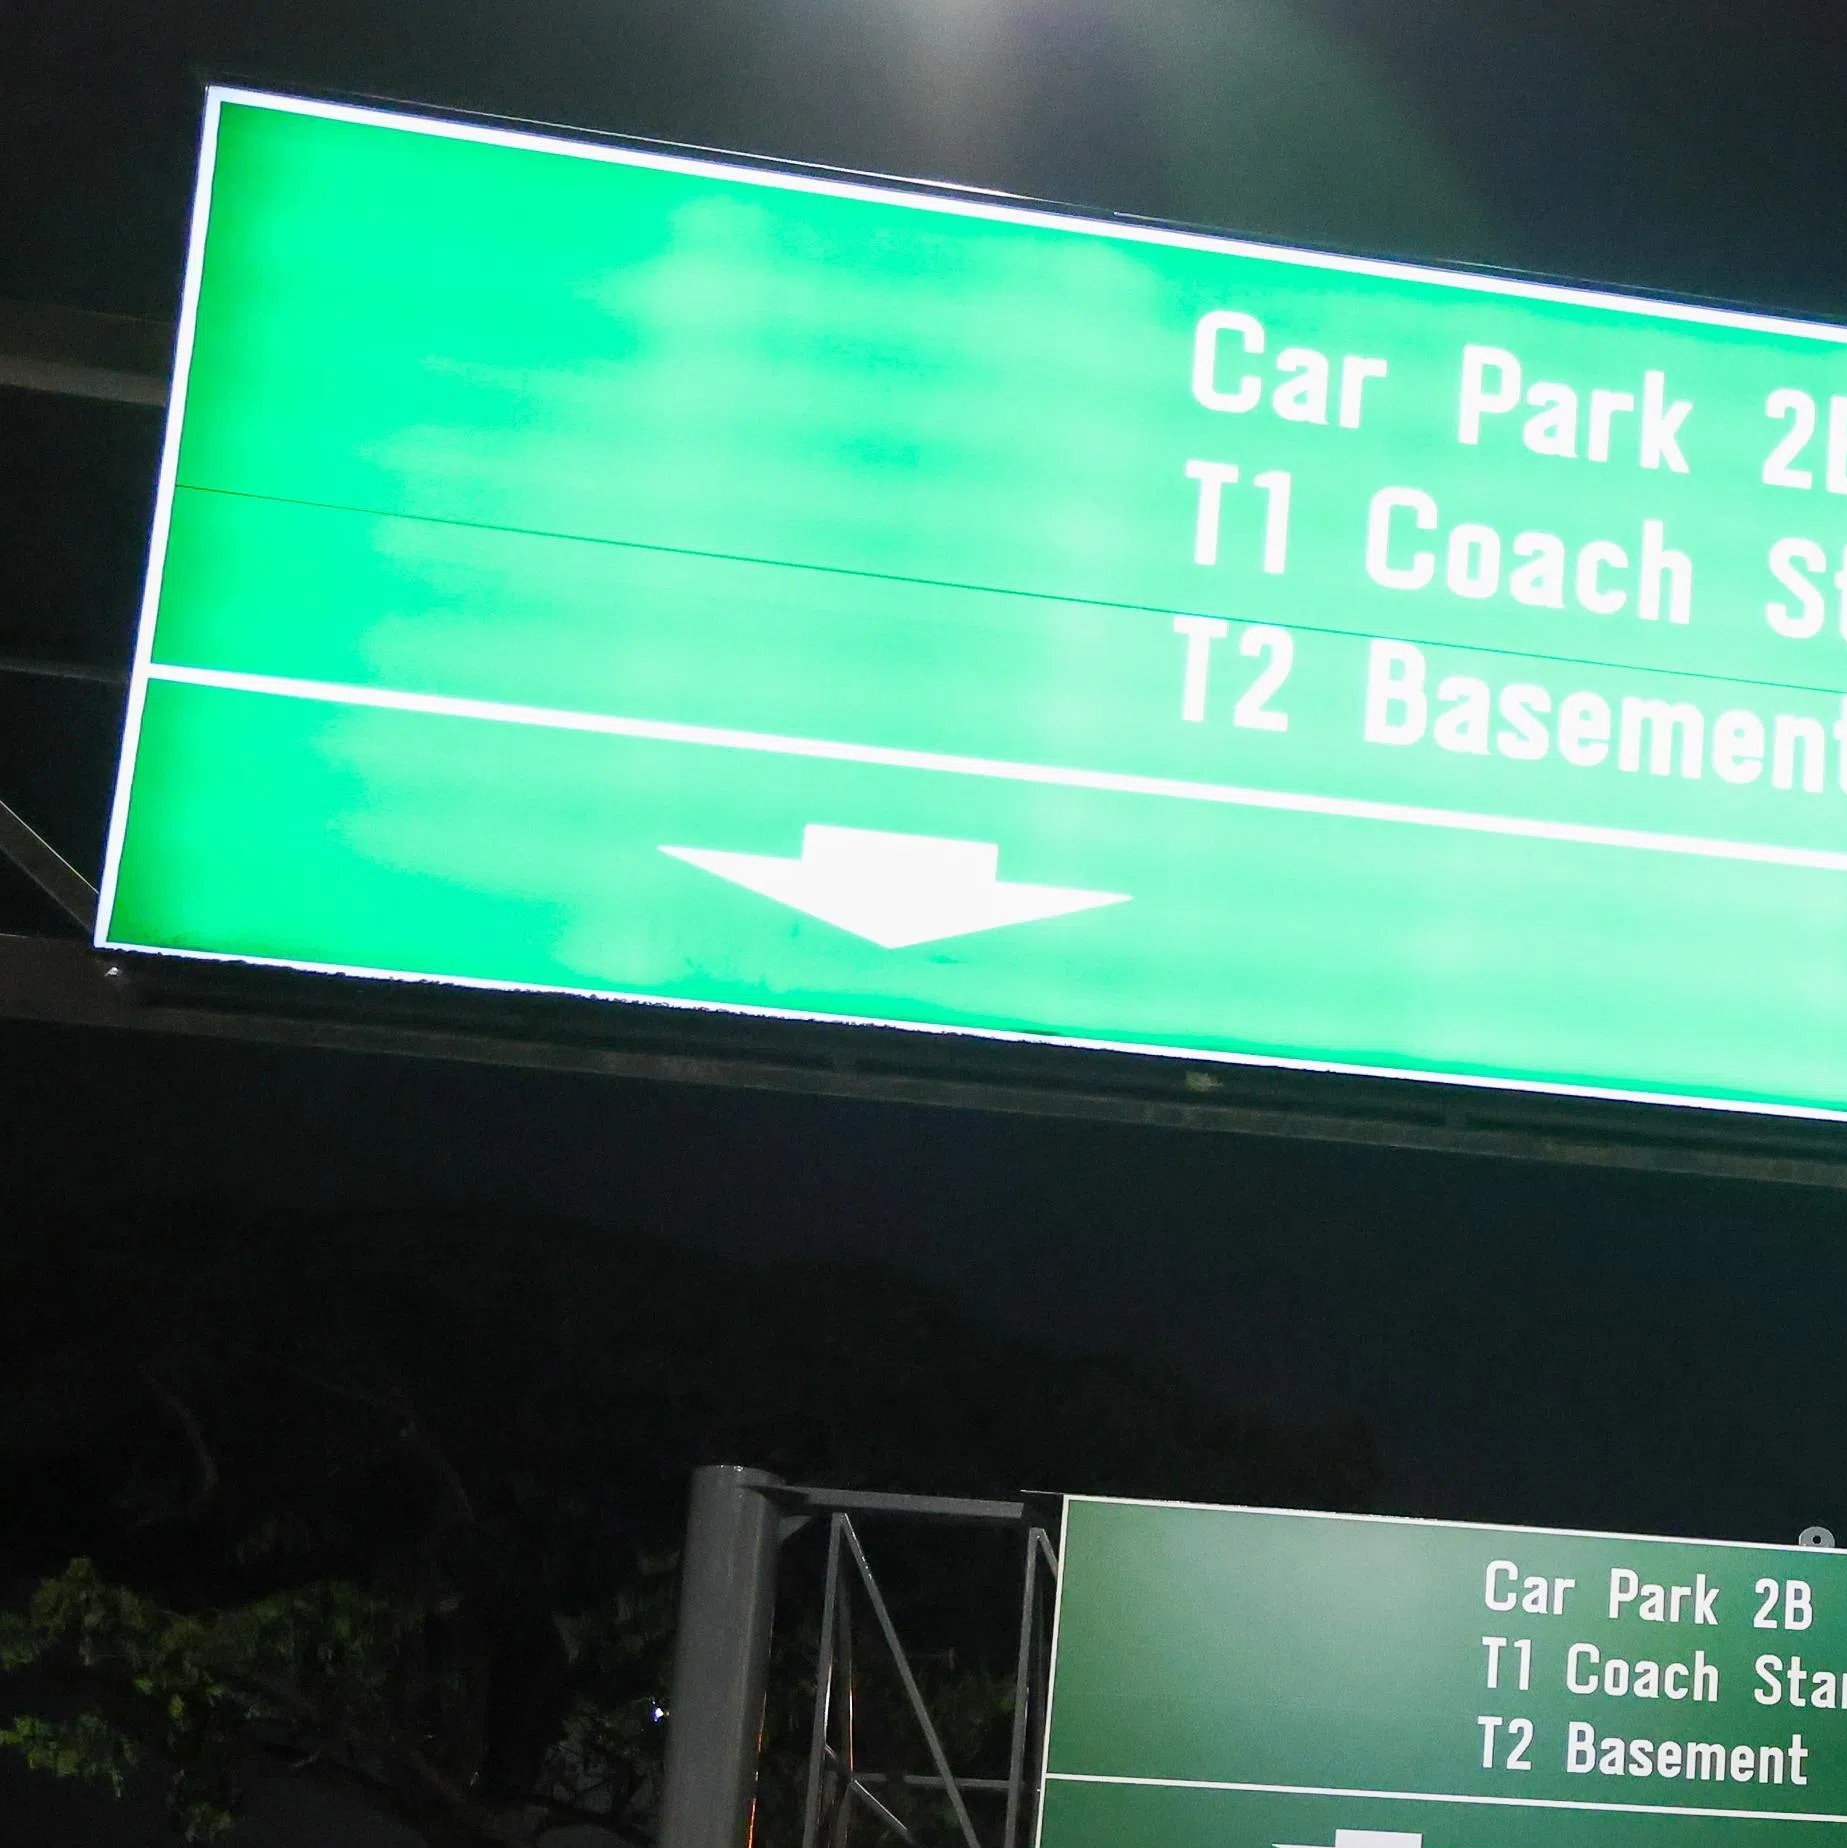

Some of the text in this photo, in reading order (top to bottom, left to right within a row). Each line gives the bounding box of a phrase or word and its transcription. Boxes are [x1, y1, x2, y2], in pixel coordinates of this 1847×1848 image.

[1192, 309, 1387, 428] Car
[1458, 344, 1692, 475] Park
[1184, 460, 1292, 574] T1
[1364, 486, 1692, 624] Coach
[1174, 613, 1294, 732] T2
[1484, 1559, 1813, 1630] Car Park 2B
[1482, 1636, 1532, 1691] T1
[1566, 1642, 1719, 1702] Coach
[1477, 1715, 1809, 1786] T2 Basement
